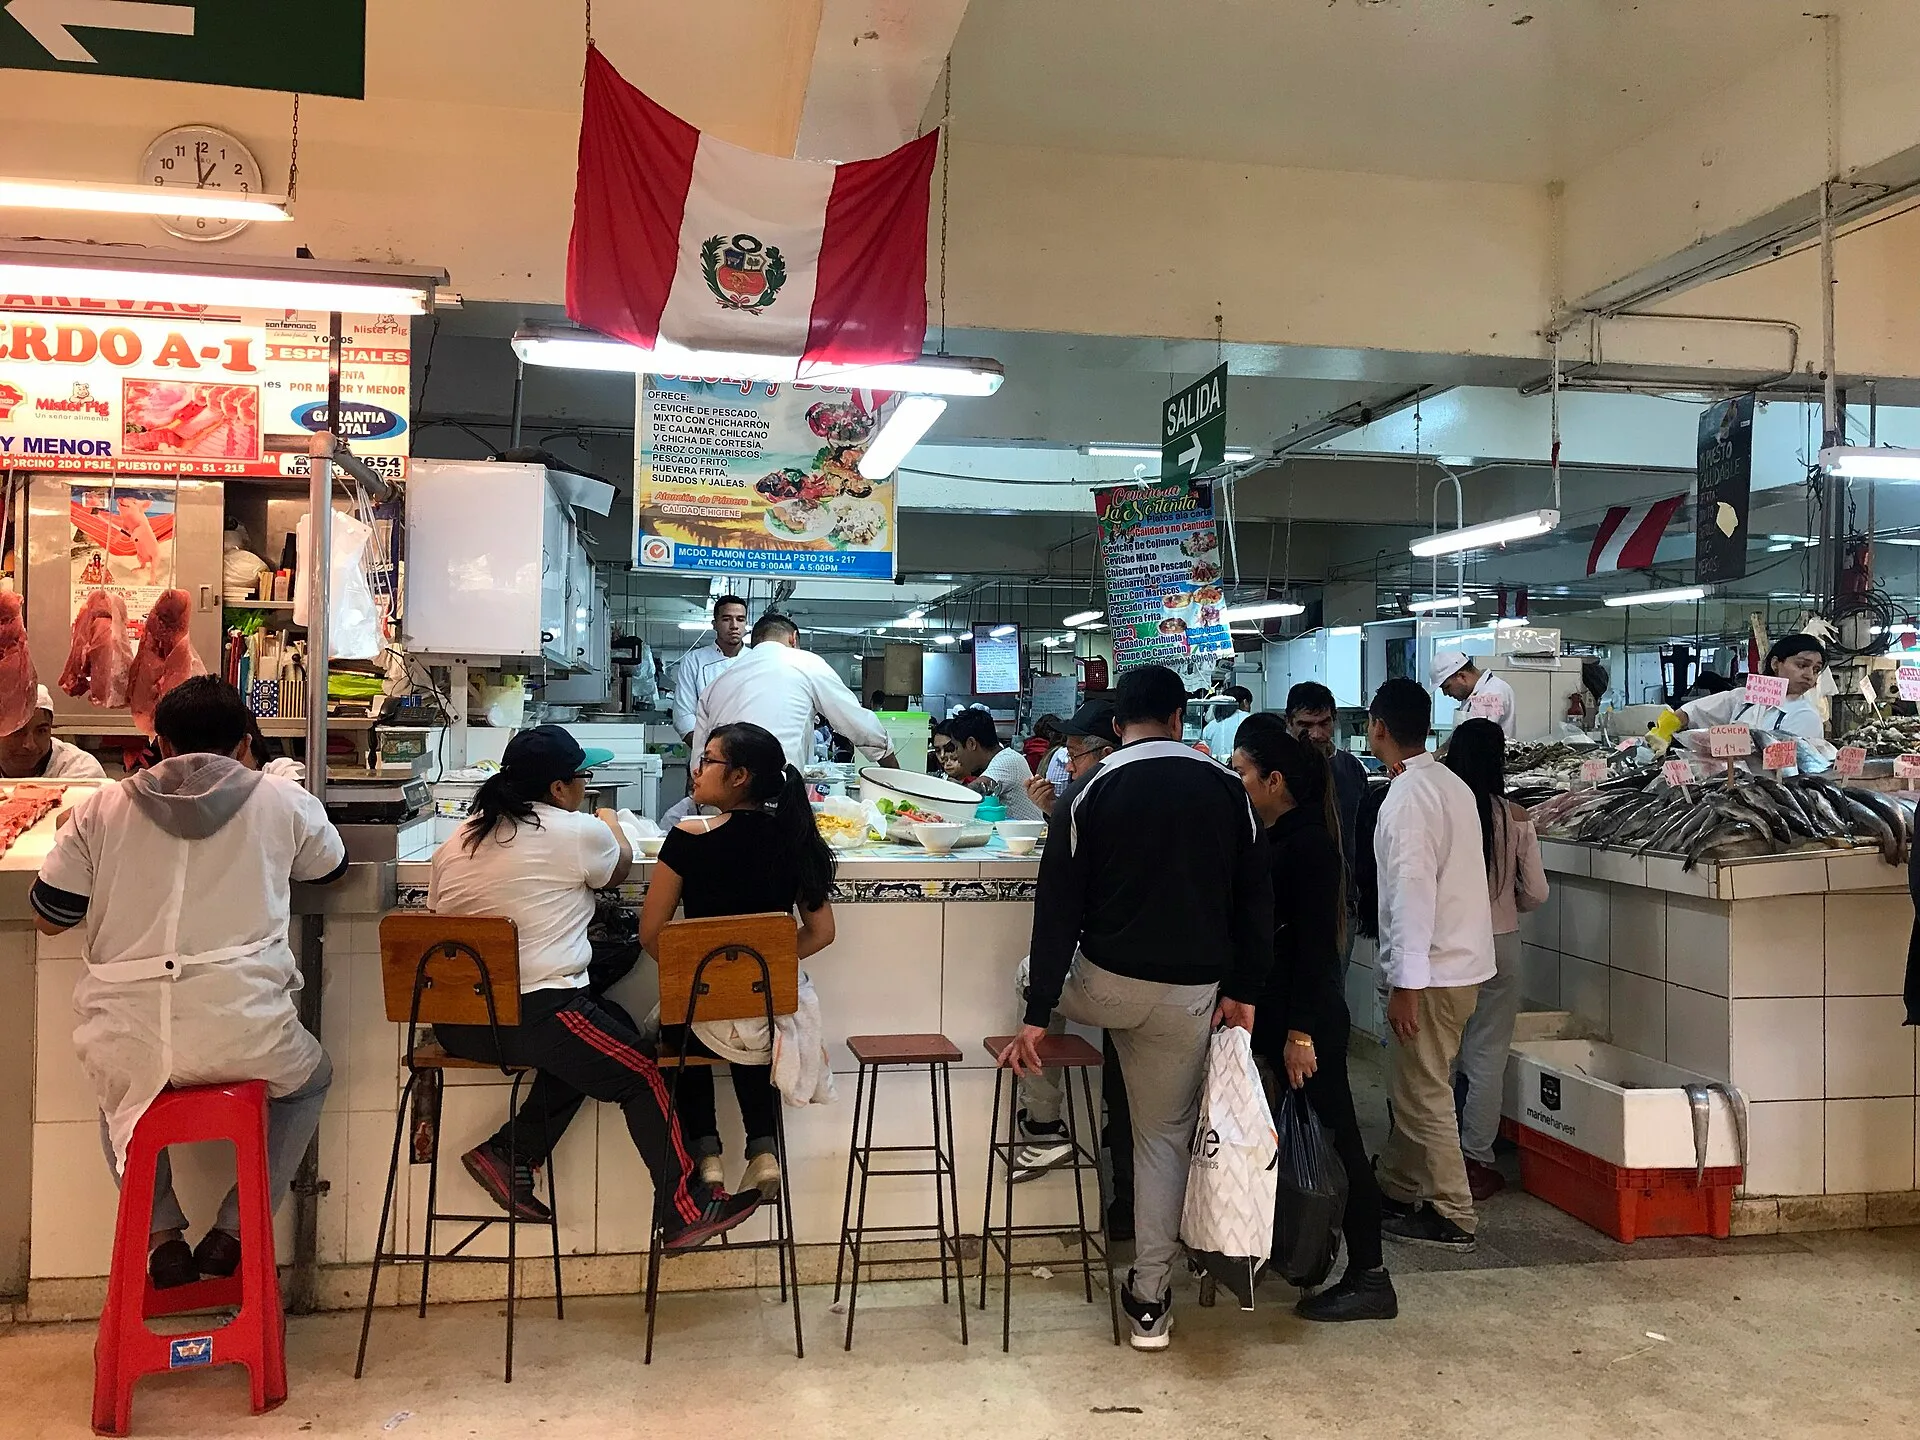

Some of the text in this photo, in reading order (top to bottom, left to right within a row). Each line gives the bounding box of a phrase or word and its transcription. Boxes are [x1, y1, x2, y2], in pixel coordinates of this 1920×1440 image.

[175, 145, 186, 157] 11
[195, 141, 209, 153] 12
[220, 149, 226, 160] 1
[160, 158, 174, 169] 10
[234, 164, 243, 175] 2
[154, 176, 164, 187] 9
[240, 182, 249, 193] 3
[196, 217, 206, 229] 6
[354, 325, 408, 337] Mister Pig
[0, 320, 142, 366] RDO
[314, 335, 354, 344] Y OOS
[290, 383, 313, 393] POR
[316, 383, 354, 393] MOR
[356, 385, 363, 393] Y
[366, 385, 406, 395] MENOR
[648, 390, 689, 402] OFRECE:
[35, 398, 110, 417] Mister Pig
[653, 403, 760, 419] CEVICHE DE PESCADO,
[1167, 376, 1221, 436] SALIDA
[35, 412, 110, 422] Un señor alimento
[653, 413, 770, 429] MIXTO CON CHICHARRÓN
[338, 423, 371, 435] OTAL
[653, 423, 768, 439] DE CALAMAR, CHILCANO
[653, 433, 659, 441] Y
[661, 434, 698, 445] CHICHA
[700, 437, 712, 445] DE
[0, 436, 112, 457] Y MENOR
[652, 444, 685, 454] ARROZ
[687, 446, 708, 455] CON
[3, 458, 55, 468] PORCINO
[57, 459, 81, 469] 2DO
[84, 460, 114, 470] PSJE.
[117, 461, 160, 471] PUESTO
[179, 463, 193, 472] 50
[202, 463, 215, 473] 51
[224, 464, 245, 473] 215
[652, 454, 698, 465] PESCADO
[652, 464, 697, 475] HUEVERA
[652, 474, 698, 484] SUDADOS
[708, 479, 747, 488] JALEAS.
[655, 492, 696, 503] Atención
[662, 505, 741, 518] CALIDAD E HIGIENE
[1100, 504, 1122, 524] La
[1147, 514, 1174, 524] Platos
[1190, 509, 1213, 518] carta
[1135, 525, 1164, 537] Calidad
[1170, 524, 1181, 533] no
[1181, 519, 1215, 532] Cantidad
[1103, 537, 1180, 554] Ceviche De Cojinova
[678, 548, 709, 557] MCDO.
[747, 551, 792, 561] CASTILLA
[793, 554, 818, 562] PSTO
[819, 555, 834, 563] 216
[841, 555, 856, 565] 217
[1105, 552, 1157, 567] Ceviche Mixto
[697, 558, 744, 568] ATENCIÓN
[746, 560, 759, 569] DE
[799, 563, 806, 571] A
[807, 563, 838, 572] 5:00PM
[1106, 560, 1192, 578] Chicharrón De Pescado
[1151, 576, 1162, 585] De
[1162, 572, 1193, 583] Calamar
[1109, 586, 1180, 603] Arroz Con Mariscos
[1110, 600, 1162, 615] Pescado Frito
[1111, 615, 1143, 627] Huevera
[1113, 628, 1133, 639] Jalea
[1114, 633, 1183, 651] Sudado/Parihuela
[1116, 650, 1140, 662] Chupe
[1141, 648, 1151, 659] de
[1152, 644, 1187, 657] Camarón
[1754, 676, 1783, 687] TRUCHA
[1753, 685, 1782, 697] CORVINA
[1752, 694, 1781, 706] BONITO
